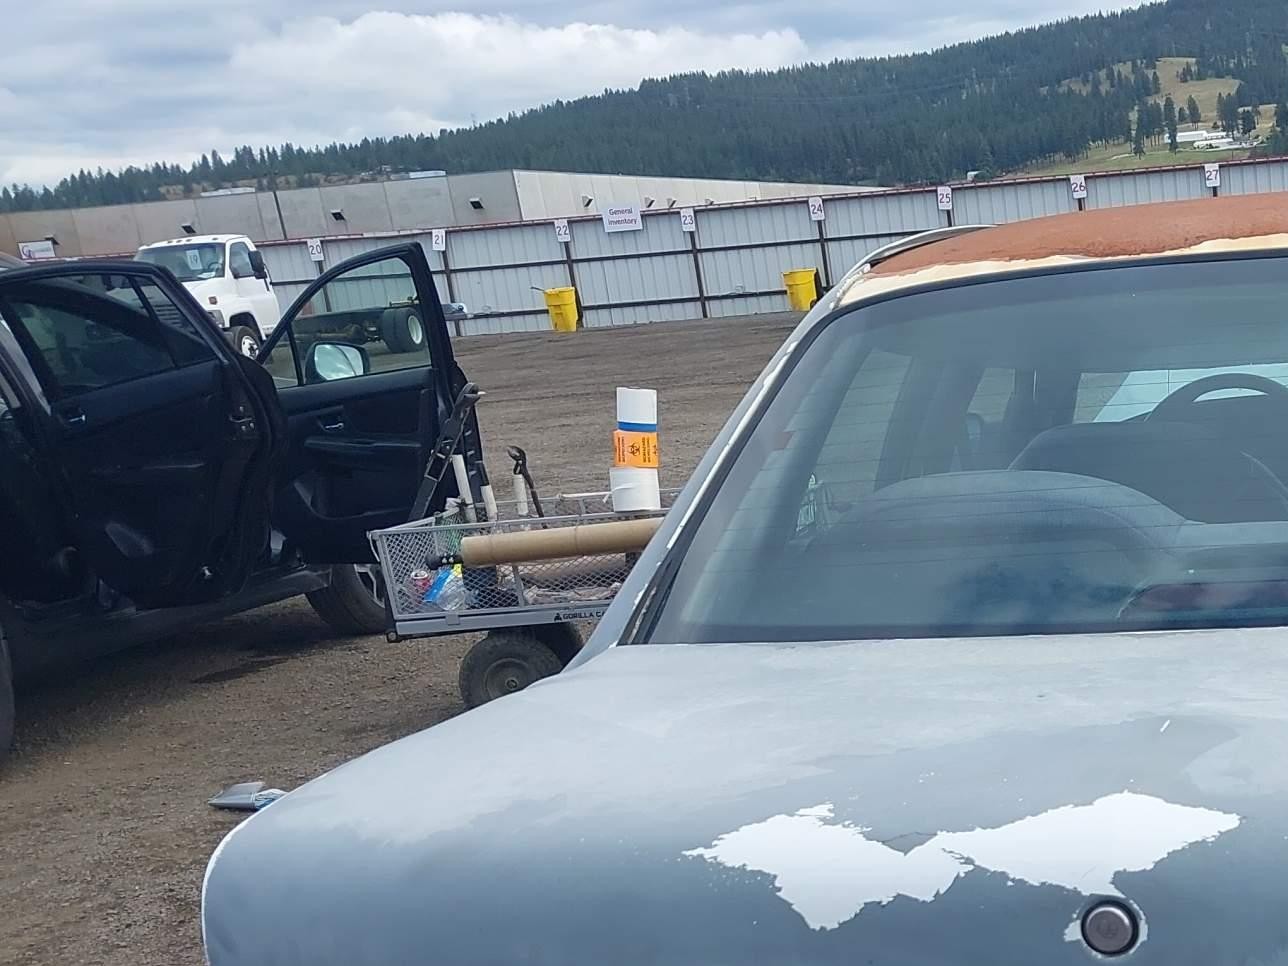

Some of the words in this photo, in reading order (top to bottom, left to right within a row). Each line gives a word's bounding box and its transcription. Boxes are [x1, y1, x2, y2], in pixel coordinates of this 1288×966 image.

[1205, 169, 1219, 181] 27
[1071, 182, 1086, 193] 26
[939, 192, 951, 204] 25
[608, 207, 633, 215] General
[811, 203, 823, 214] 24
[682, 214, 694, 225] 23
[557, 225, 569, 236] 22
[434, 234, 444, 245] 21
[309, 244, 322, 255] 20
[189, 254, 198, 264] 19
[563, 611, 594, 620] GORILLA
